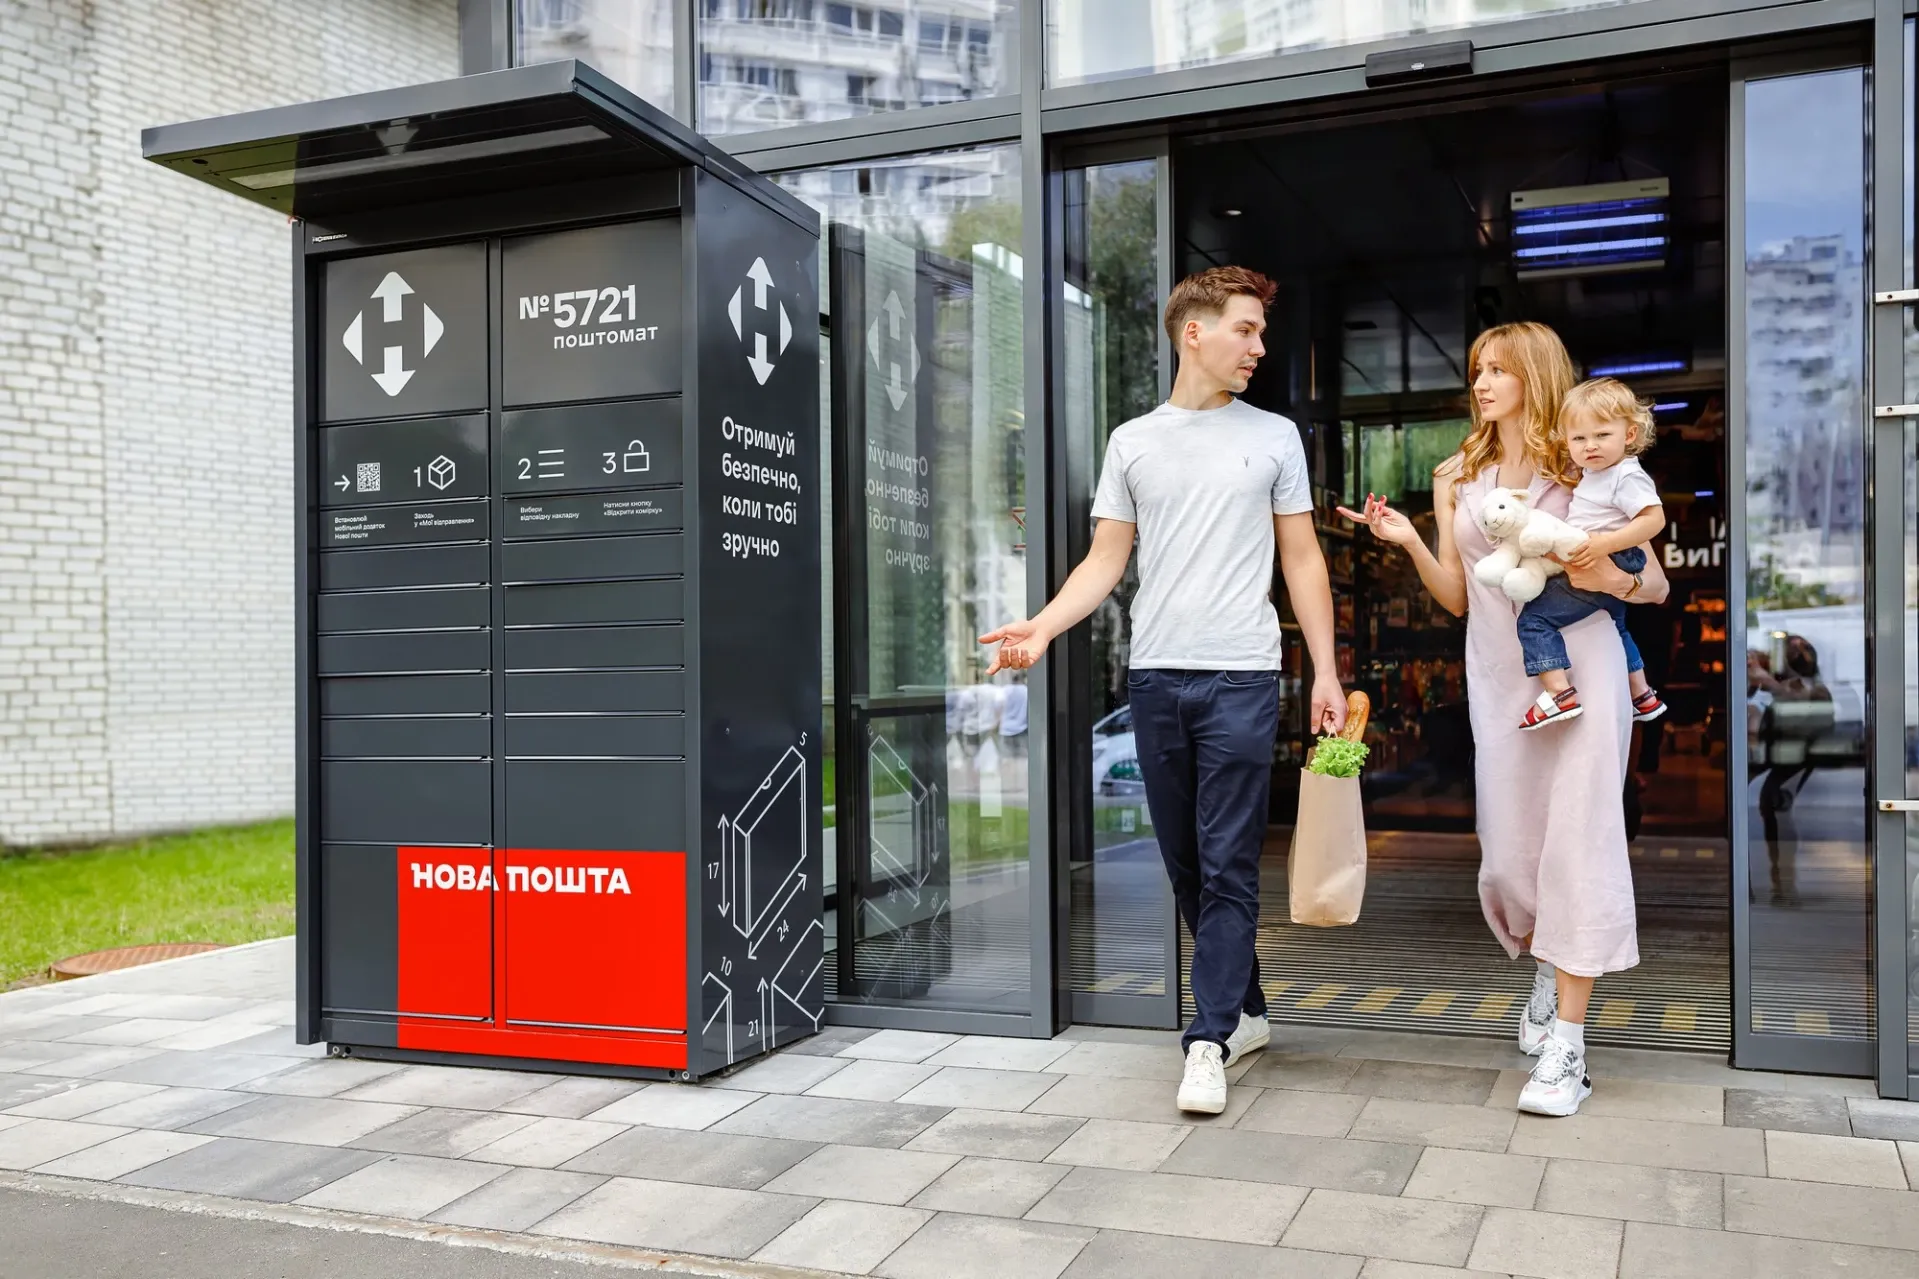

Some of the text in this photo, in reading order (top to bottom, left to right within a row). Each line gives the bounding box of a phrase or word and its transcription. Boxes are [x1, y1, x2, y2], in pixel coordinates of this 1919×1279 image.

[553, 326, 659, 349] поштомат
[721, 416, 796, 458] Отримуй
[518, 458, 532, 480] 2
[602, 452, 617, 474] 3
[722, 453, 801, 495] безпечно,
[413, 466, 422, 488] 1
[520, 506, 543, 514] Вибери
[630, 500, 653, 508] кнопку
[722, 494, 797, 525] коли тобі
[722, 532, 780, 559] зручно
[410, 862, 632, 895] НОВА ПОШТА
[707, 862, 720, 880] 17
[776, 919, 791, 943] 24
[721, 956, 732, 977] 10
[748, 1019, 760, 1038] 21
